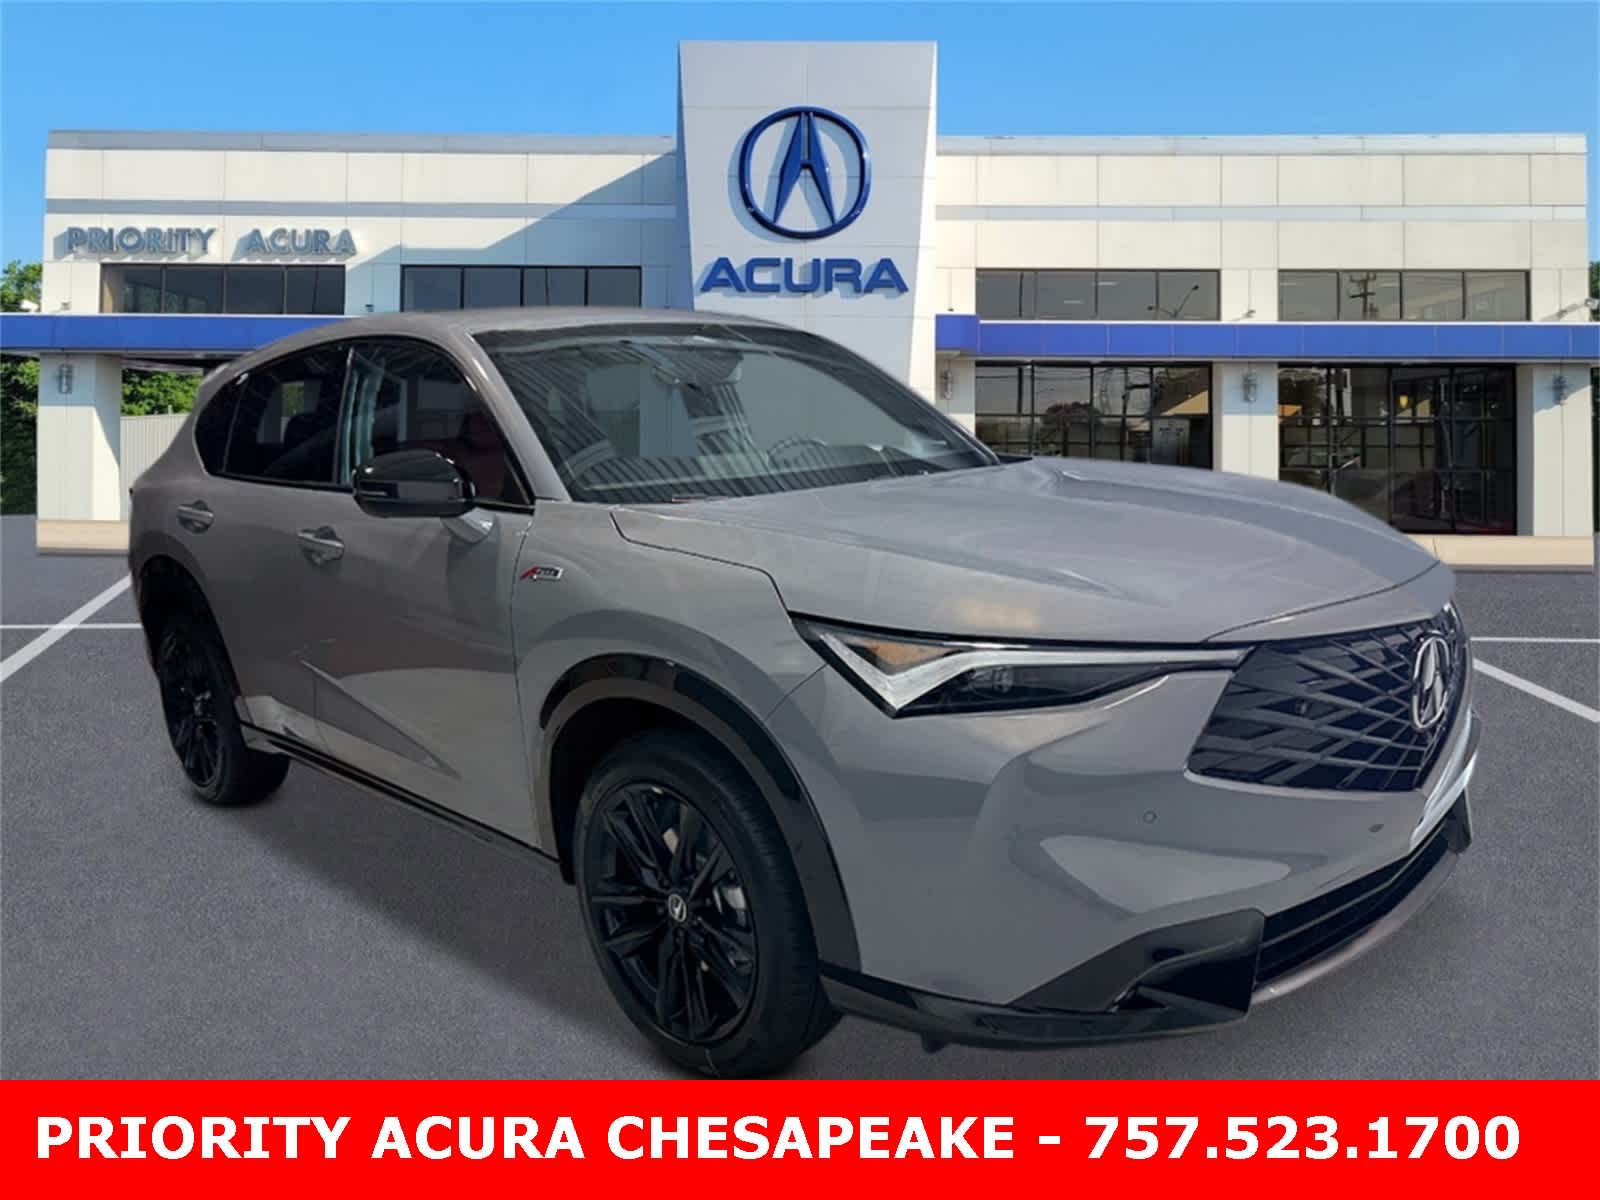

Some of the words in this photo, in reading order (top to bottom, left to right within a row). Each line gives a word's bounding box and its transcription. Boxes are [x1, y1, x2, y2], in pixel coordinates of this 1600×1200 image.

[66, 226, 216, 255] PRIORITY
[248, 227, 358, 257] ACURA
[700, 256, 909, 293] ACURA
